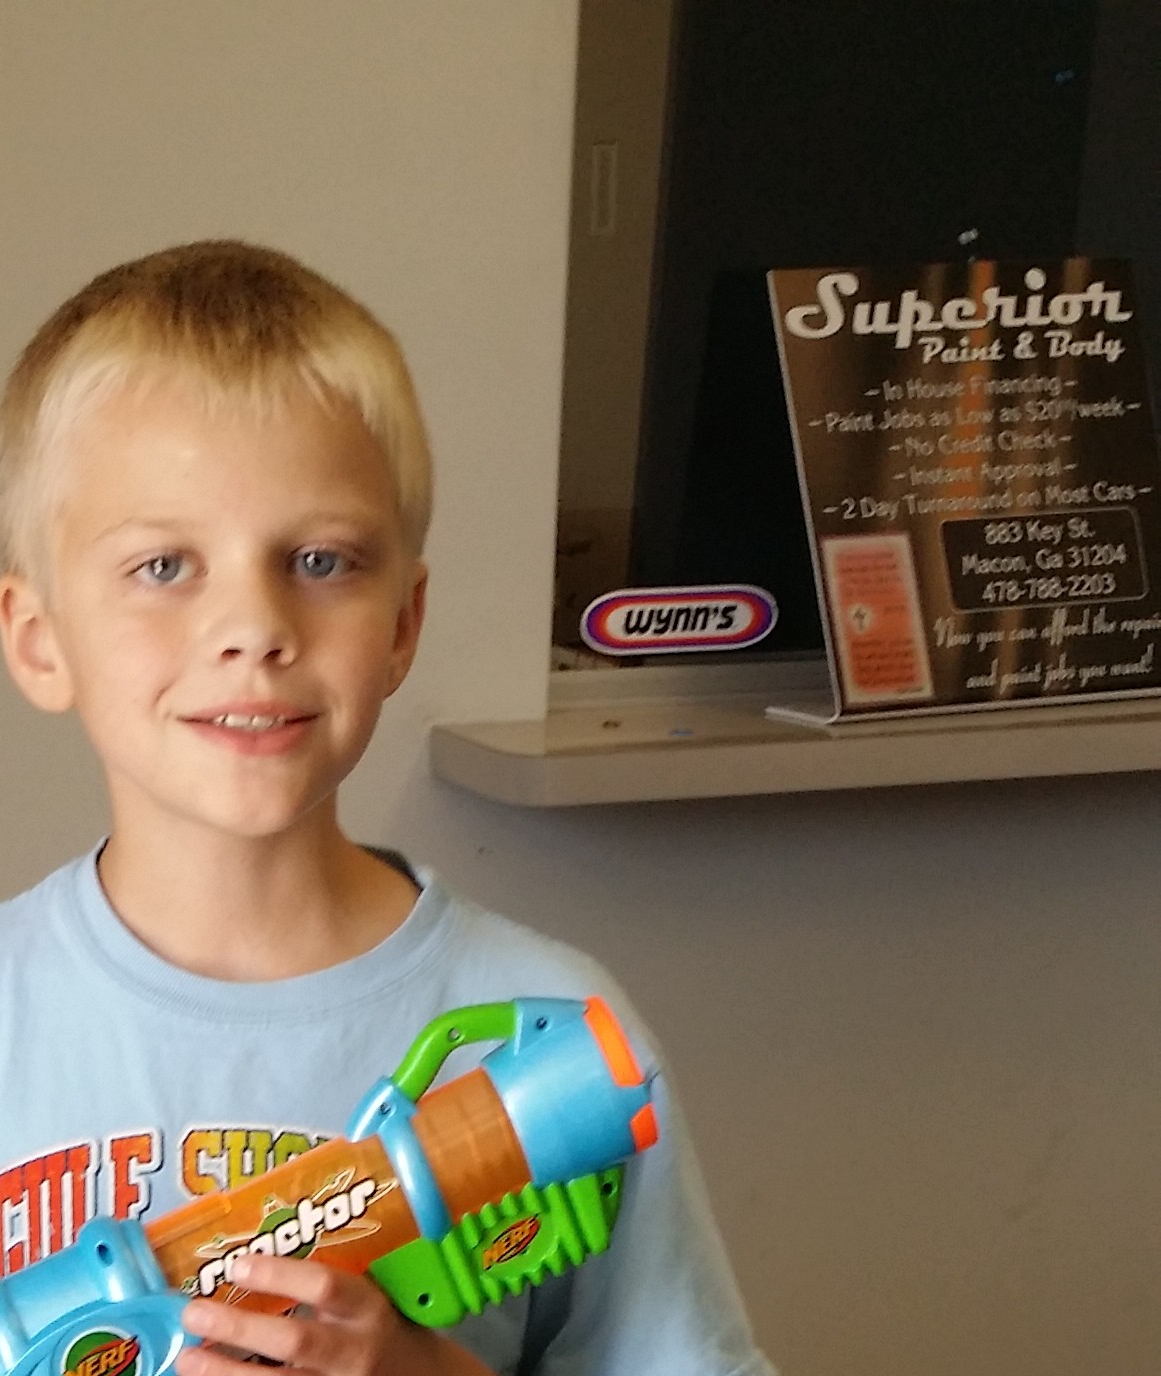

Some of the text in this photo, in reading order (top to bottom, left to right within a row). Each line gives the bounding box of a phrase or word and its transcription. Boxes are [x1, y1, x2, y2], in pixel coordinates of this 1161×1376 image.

[784, 268, 1134, 349] Superior
[917, 329, 1127, 364] Paint & Body
[906, 377, 966, 400] House
[825, 411, 875, 433] Paint
[878, 408, 926, 430] Jobs
[928, 411, 952, 427] as
[955, 406, 995, 425] Low
[999, 406, 1022, 422] as
[904, 428, 1059, 457] No Credit Check
[909, 456, 1062, 486] Instant Approval
[841, 480, 1138, 521] 2 Day Turnaround on Most Cars
[983, 520, 1024, 545] 883
[1025, 518, 1064, 545] Key
[1035, 548, 1064, 570] Ga
[1066, 543, 1127, 568] 31204
